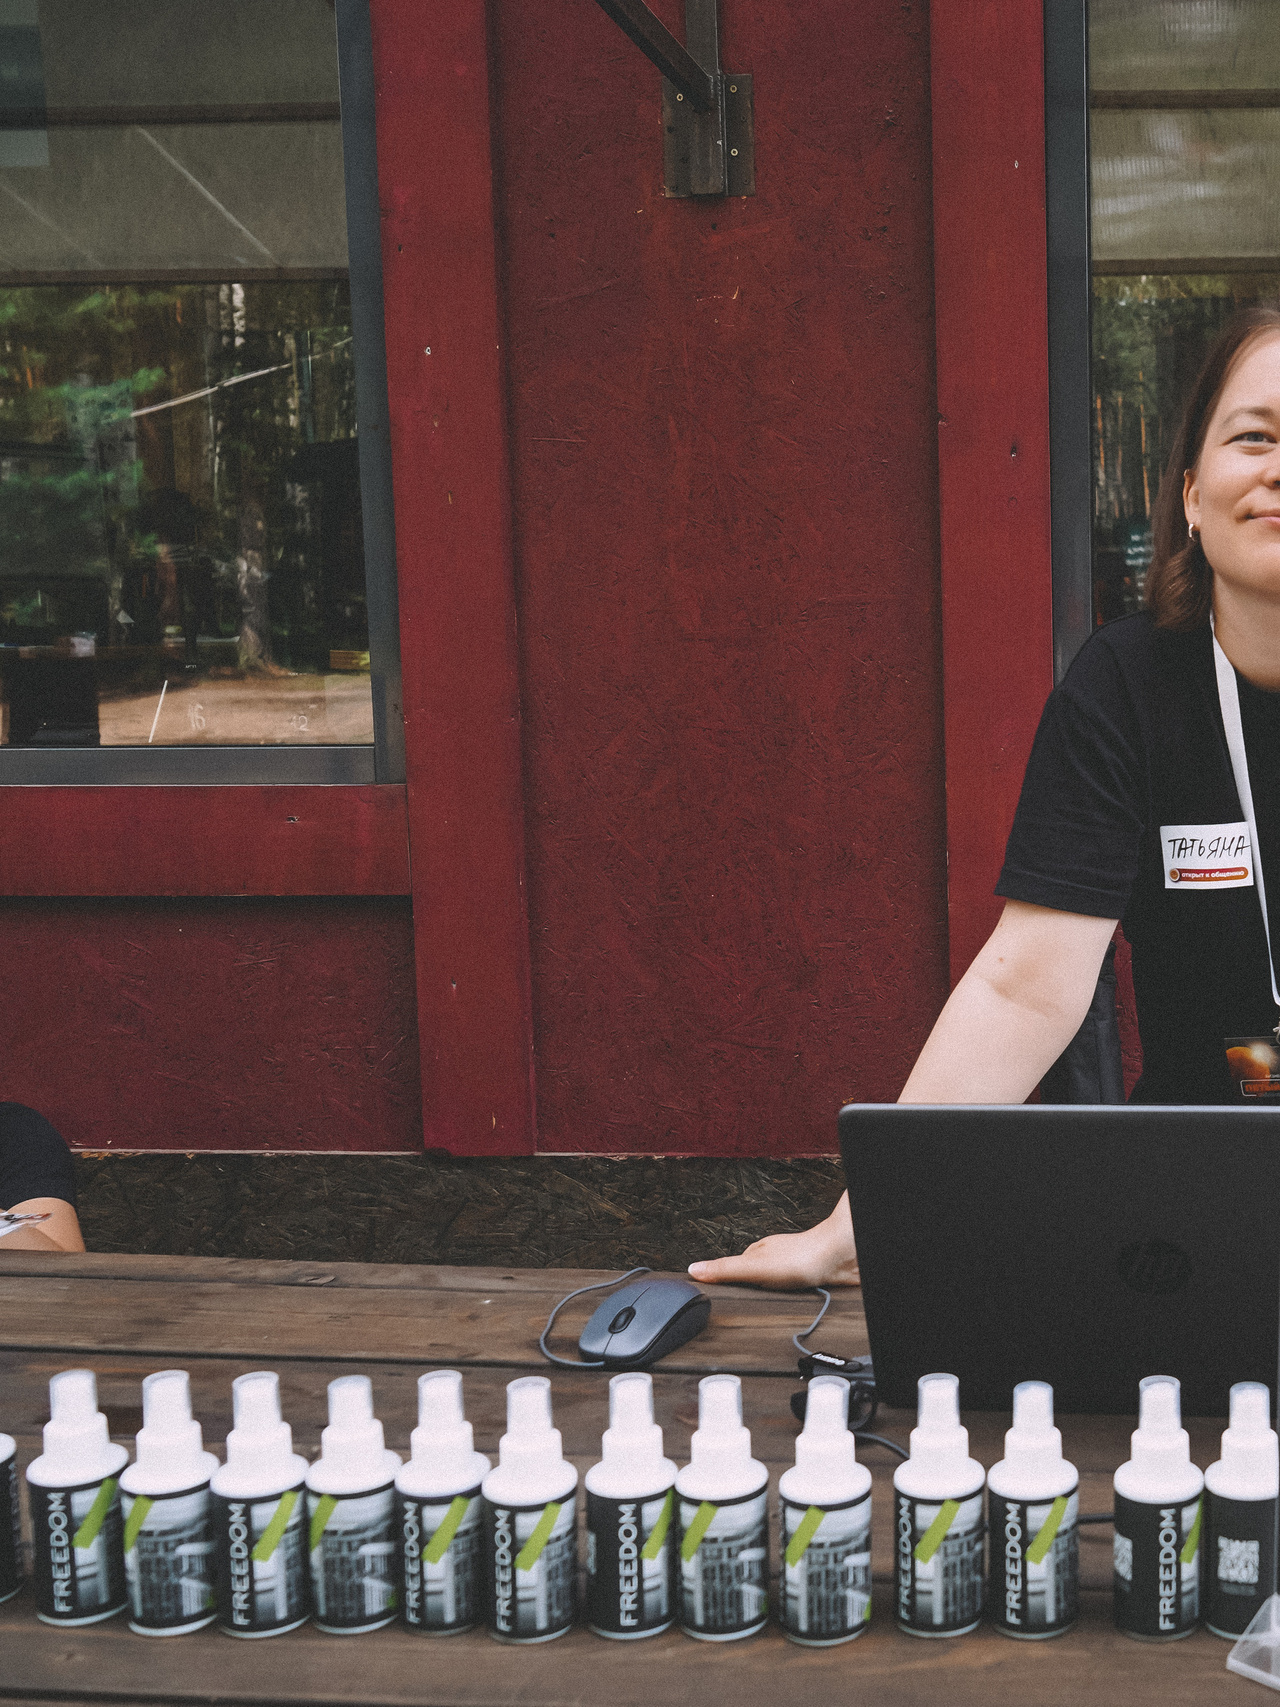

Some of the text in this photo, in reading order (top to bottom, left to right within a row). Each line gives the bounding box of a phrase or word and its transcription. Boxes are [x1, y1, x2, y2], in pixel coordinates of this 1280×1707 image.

[1168, 835, 1251, 859] ТАТЬЯНА
[1211, 870, 1245, 878] общению
[48, 1492, 73, 1613] FREEDOM
[228, 1503, 251, 1626] FREEDOM
[403, 1501, 421, 1624] FREEDOM
[494, 1509, 512, 1632] FREEDOM
[618, 1503, 639, 1627] FREEDOM
[898, 1498, 912, 1621] FREEDOM
[1004, 1502, 1022, 1625] FREEDOM
[1158, 1508, 1177, 1631] FREEDOM
